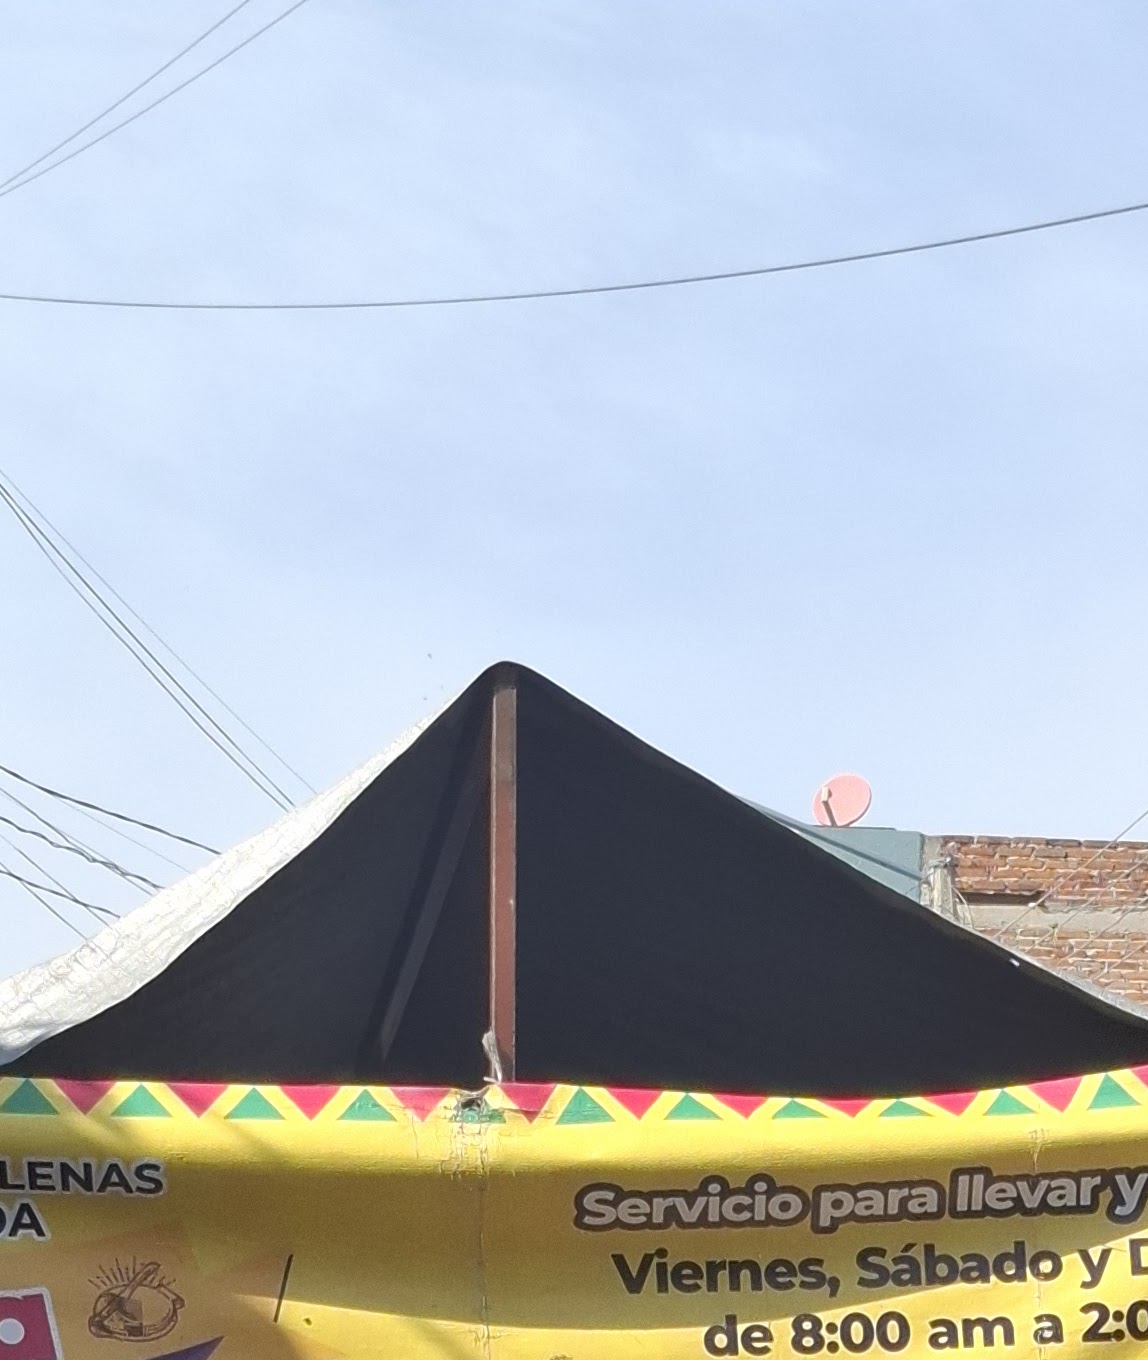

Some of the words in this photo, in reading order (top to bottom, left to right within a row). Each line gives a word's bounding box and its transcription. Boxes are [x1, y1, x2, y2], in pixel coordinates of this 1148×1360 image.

[579, 1179, 805, 1229] Servicio
[816, 1182, 941, 1229] para
[954, 1171, 1102, 1213] llevar
[611, 1248, 841, 1298] Viernes,
[855, 1240, 1064, 1288] Sábado
[1077, 1248, 1114, 1289] y
[703, 1314, 775, 1357] de
[791, 1310, 912, 1355] 8:00
[928, 1314, 1016, 1351] am
[1032, 1312, 1064, 1345] a
